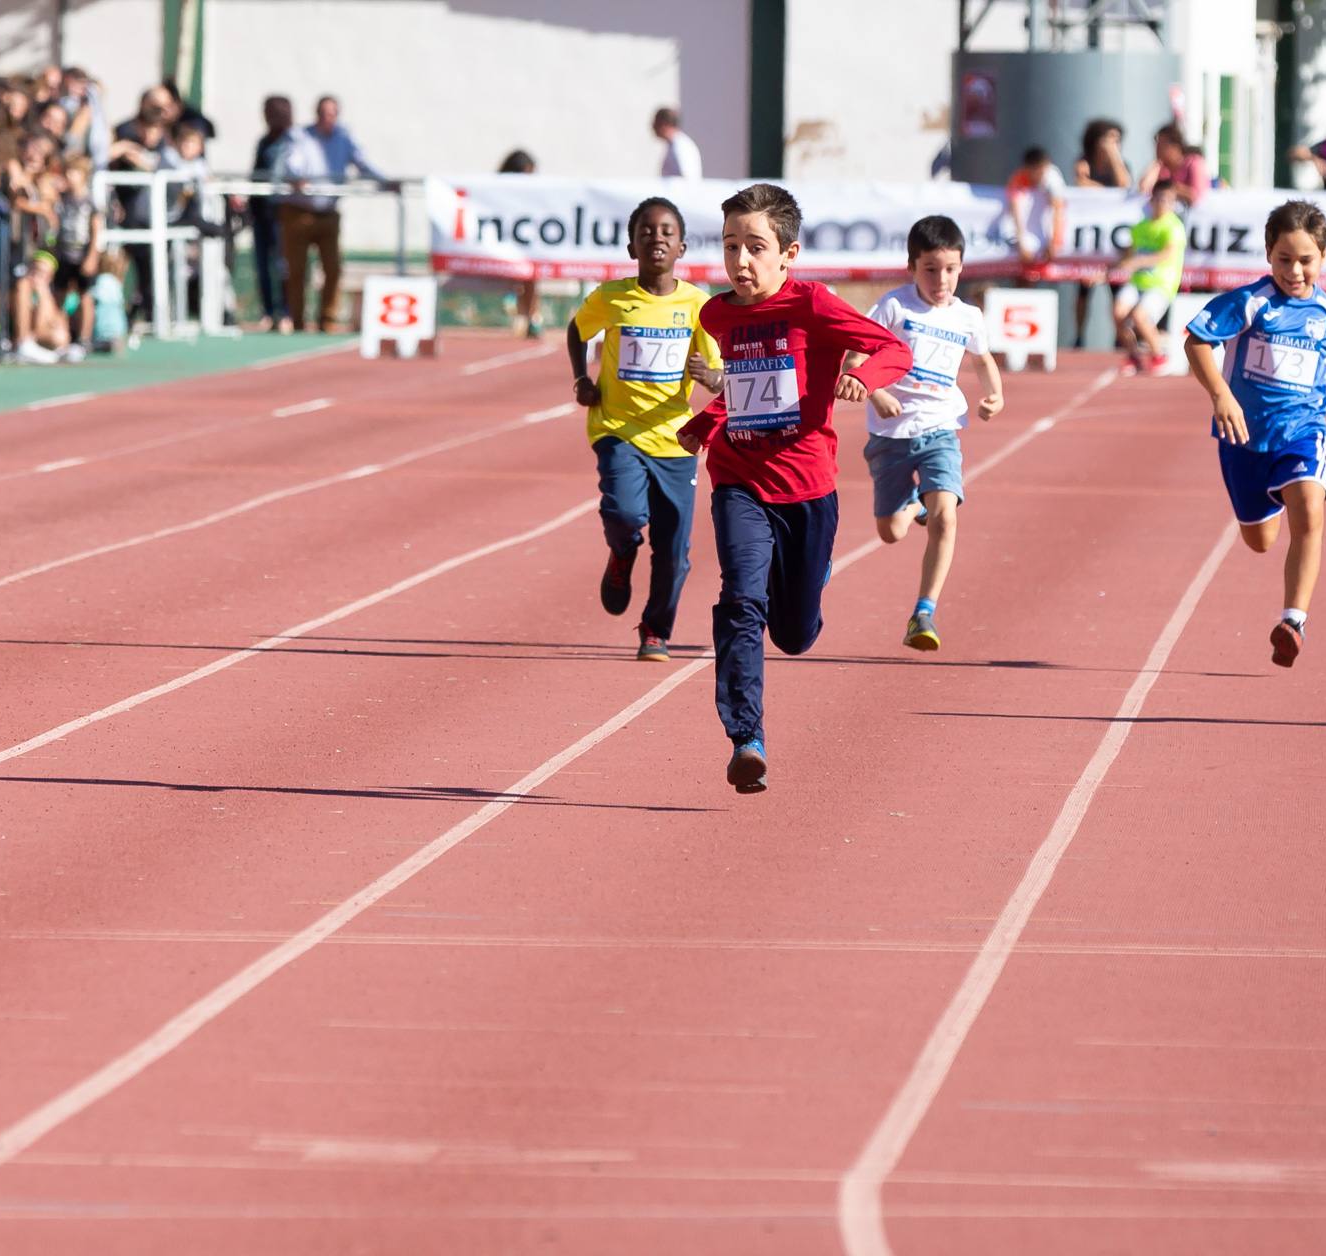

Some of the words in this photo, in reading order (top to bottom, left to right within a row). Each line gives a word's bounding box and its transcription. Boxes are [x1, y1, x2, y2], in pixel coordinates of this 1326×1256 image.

[452, 188, 621, 246] incolu
[380, 292, 418, 328] 8
[1003, 306, 1038, 340] 5
[643, 327, 688, 338] HEMAFIX
[775, 338, 788, 351] 96
[1272, 334, 1316, 350] HEMAFIX
[626, 340, 680, 368] 176
[733, 358, 788, 373] HEMAFIX
[909, 336, 955, 371] 175
[1252, 344, 1305, 378] 173
[725, 375, 782, 412] 174
